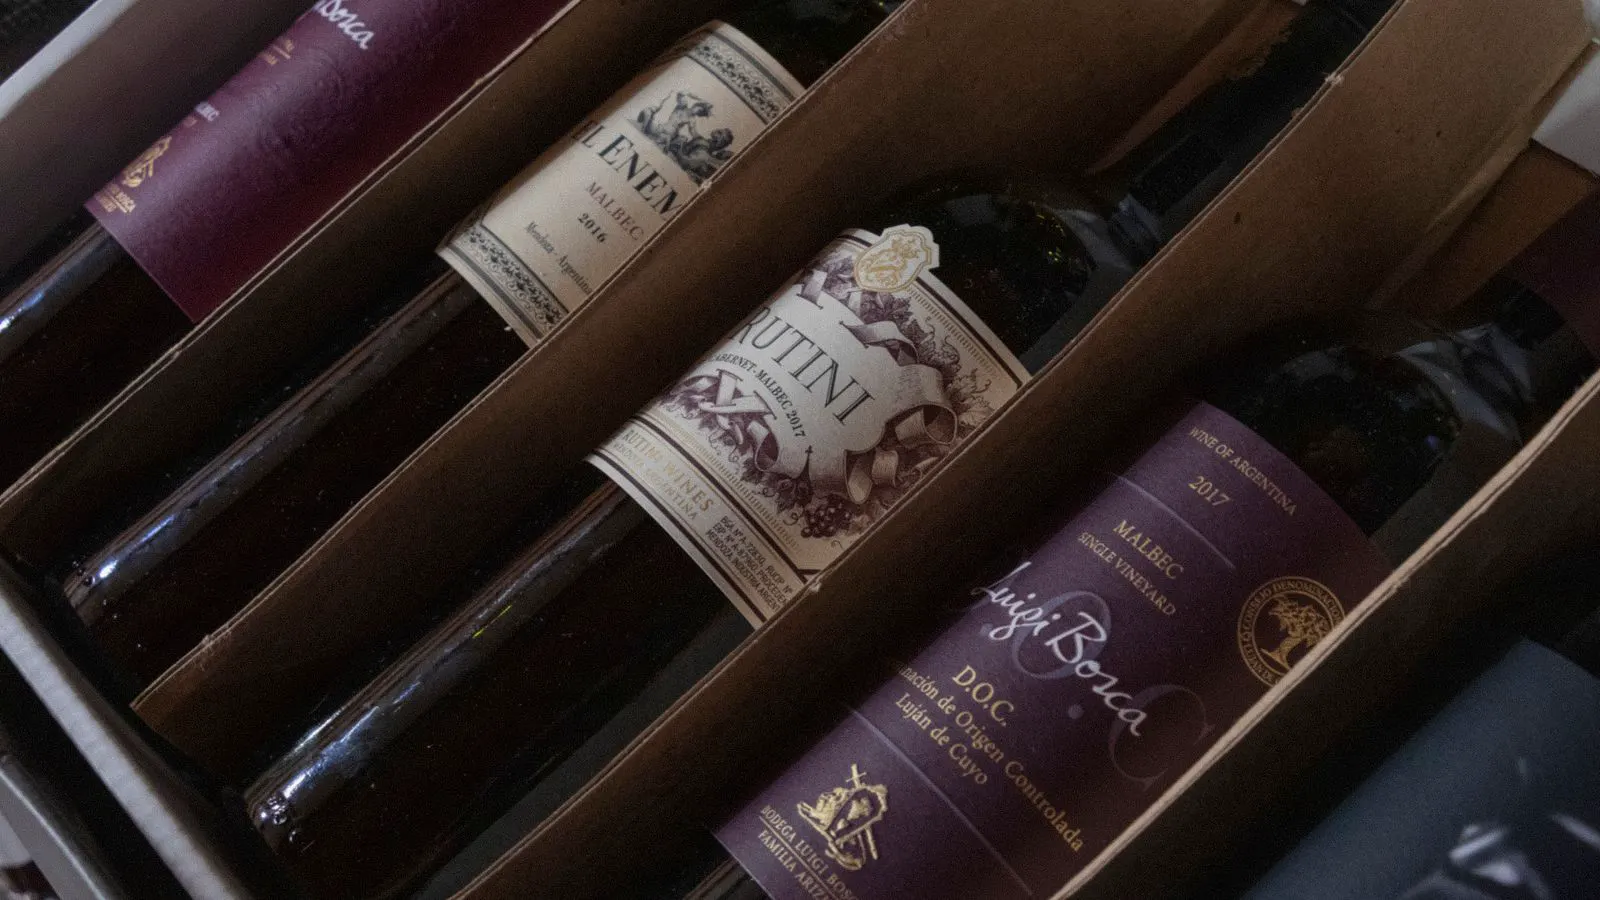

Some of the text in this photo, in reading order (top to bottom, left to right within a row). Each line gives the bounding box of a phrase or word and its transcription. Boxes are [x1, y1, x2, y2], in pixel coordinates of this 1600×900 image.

[577, 212, 608, 243] 2016
[585, 182, 645, 241] MALBEC
[730, 306, 875, 426] RUTINI
[786, 409, 807, 438] 2017
[1188, 475, 1231, 507] 2017
[1191, 426, 1298, 516] WINE OF ARGENTINA
[1078, 531, 1176, 616] SINGLE VINEYARD
[1113, 519, 1184, 580] MALBEC
[971, 561, 1062, 640] Luigi
[1045, 612, 1146, 737] Bosca
[952, 664, 1015, 727] D.O.C.
[895, 692, 988, 785] Luján de Cuyo
[936, 695, 957, 715] de
[955, 711, 1005, 763] Origen
[1004, 760, 1085, 852] Controlada
[758, 829, 798, 873] FAMILIA
[759, 804, 797, 843] BODEGA
[795, 839, 830, 875] LUIGI
